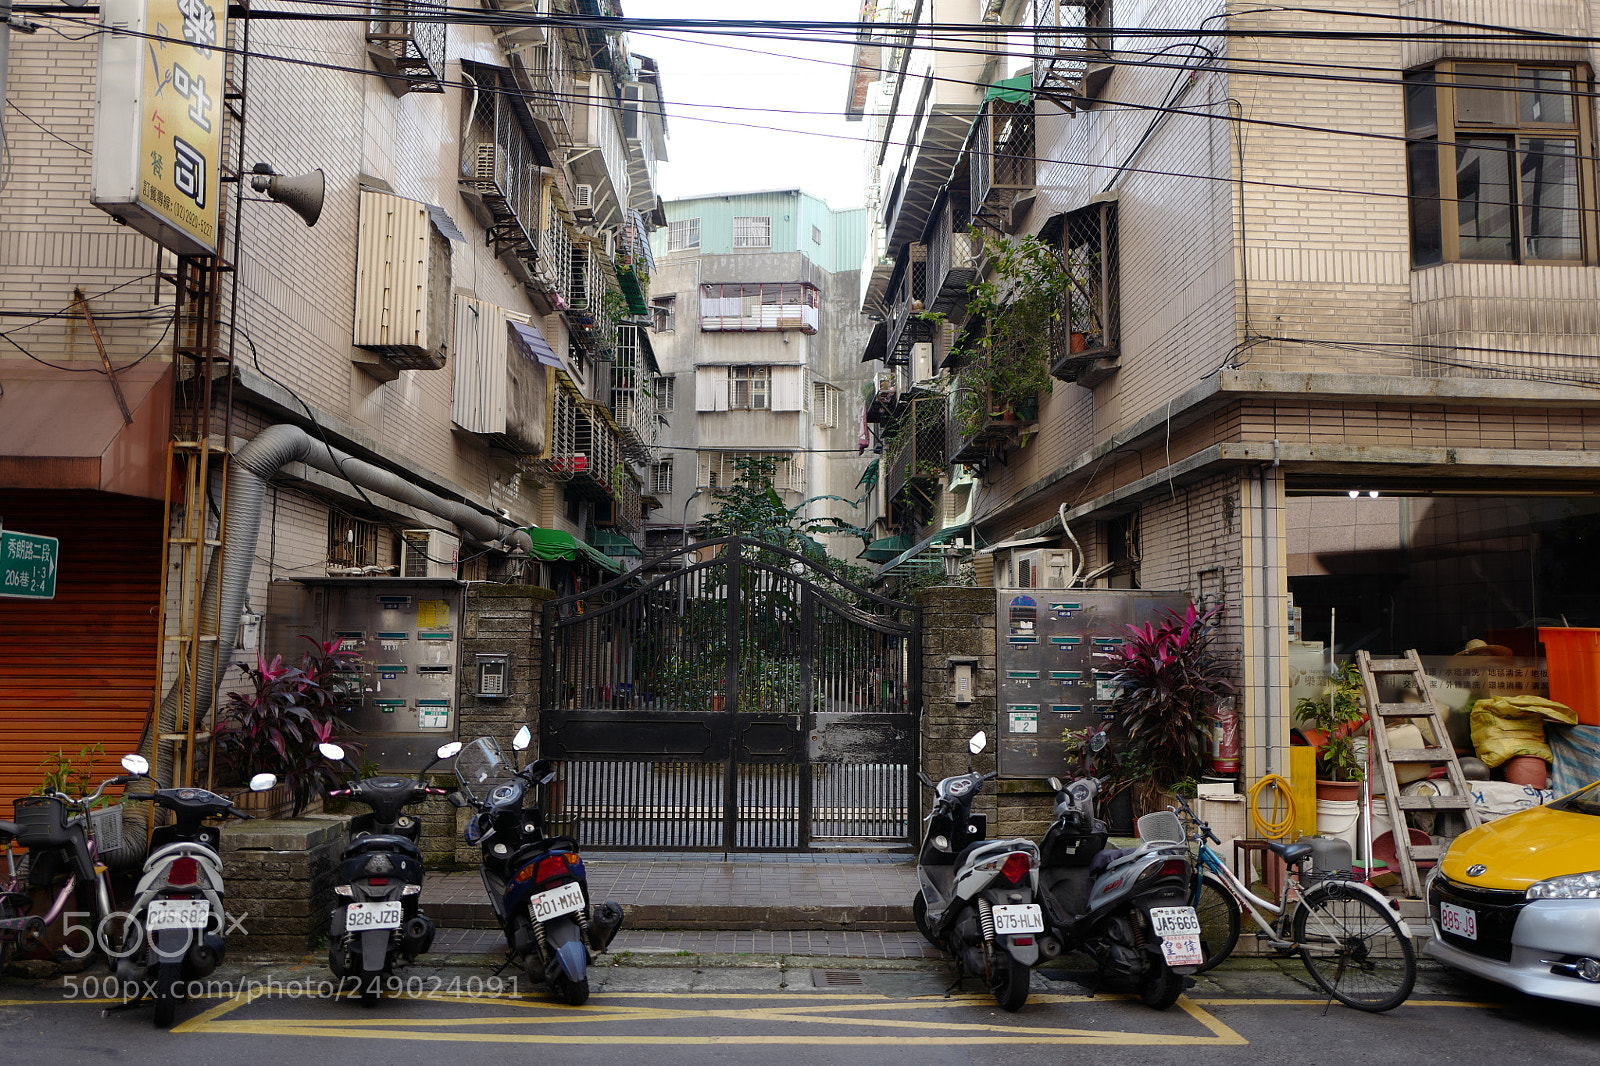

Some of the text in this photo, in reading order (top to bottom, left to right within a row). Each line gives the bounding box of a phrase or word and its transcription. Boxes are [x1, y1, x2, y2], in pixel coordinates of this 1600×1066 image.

[8, 538, 50, 562] 秀朗路二段
[5, 569, 29, 587] 206巷
[535, 890, 583, 917] 201-MXH
[348, 910, 400, 926] 928-JZB
[996, 913, 1042, 929] 875-HLN
[1155, 916, 1198, 931] JA5-666
[1442, 909, 1475, 935] 885-J9
